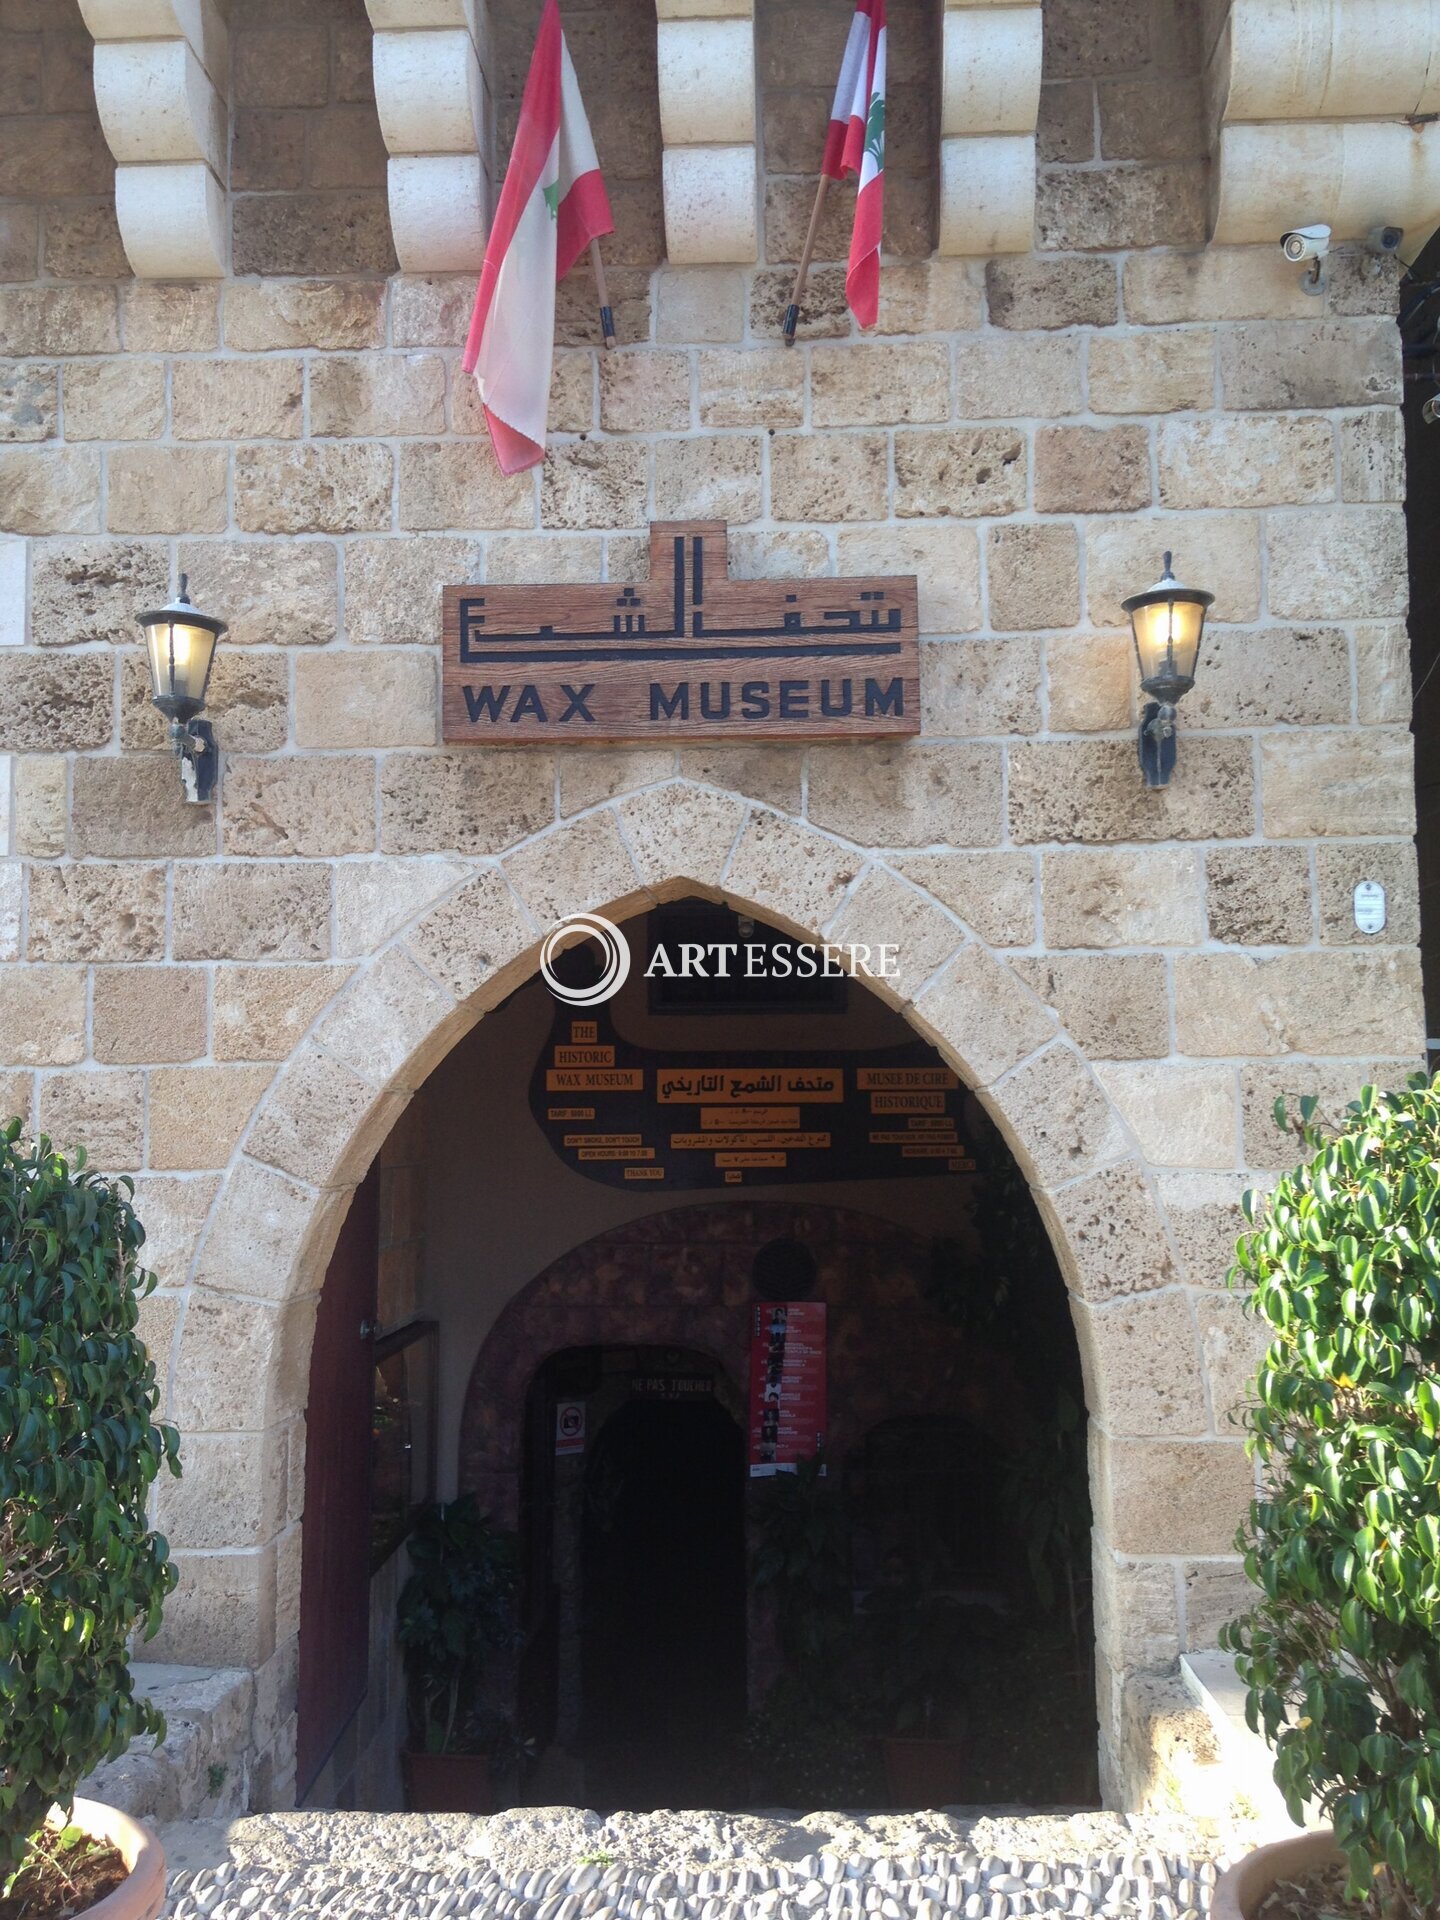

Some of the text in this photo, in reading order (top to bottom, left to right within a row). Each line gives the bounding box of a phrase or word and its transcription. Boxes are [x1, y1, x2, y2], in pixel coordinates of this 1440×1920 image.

[462, 677, 904, 723] WAX MUSEUM
[573, 1026, 596, 1039] THE
[559, 1051, 613, 1063] HISTORIC
[556, 1073, 634, 1086] WAX MUSEUM
[905, 1072, 922, 1086] DE
[922, 1071, 949, 1085] CIRE
[662, 1075, 835, 1099] متحف الشمع التاريخي
[874, 1095, 944, 1110] HISTORIQUE
